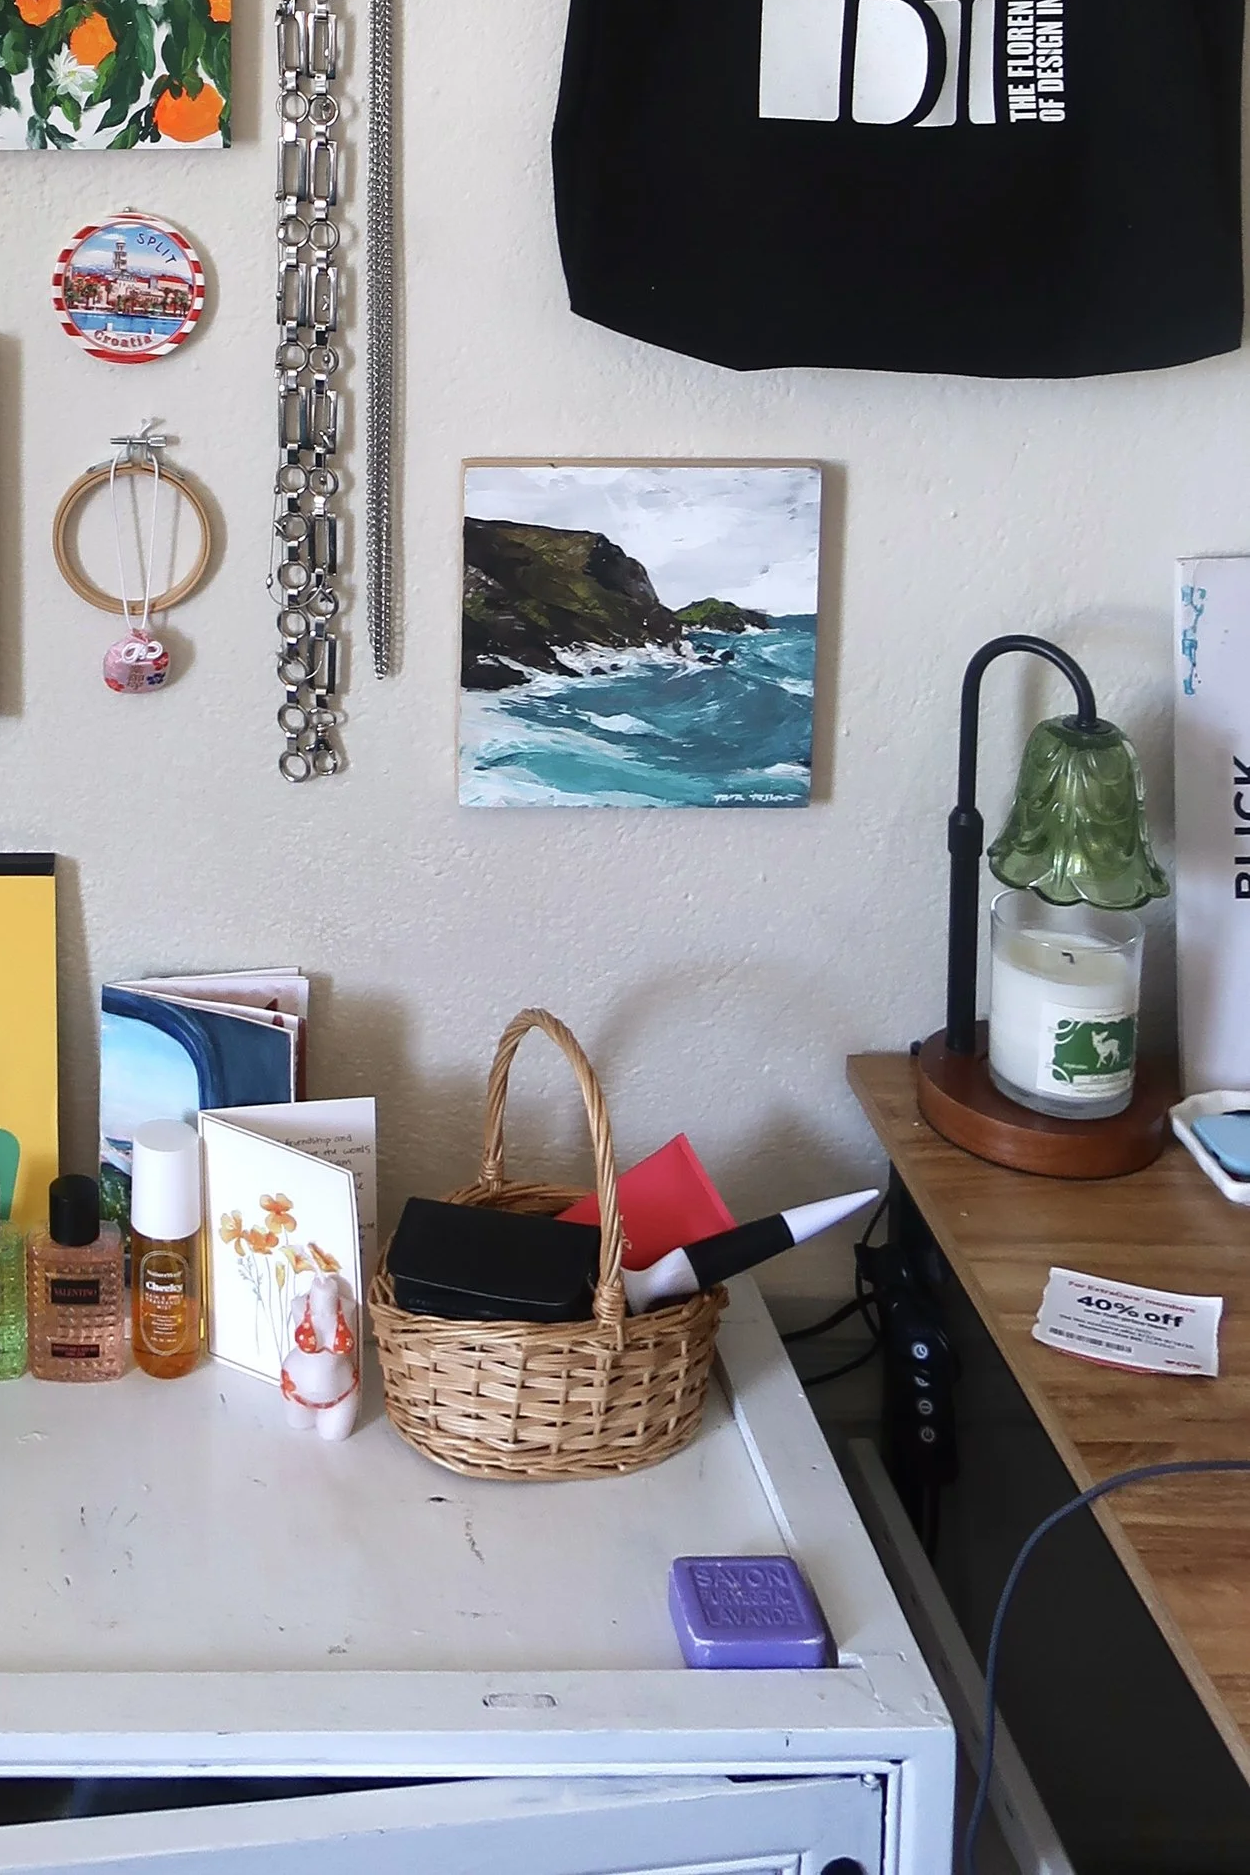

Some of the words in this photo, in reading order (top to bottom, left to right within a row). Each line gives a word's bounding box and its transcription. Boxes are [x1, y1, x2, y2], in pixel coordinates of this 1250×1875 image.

[1036, 21, 1064, 92] DESIGN
[1007, 84, 1037, 123] THE
[1038, 98, 1065, 123] OF
[137, 233, 177, 264] SPLIT
[93, 330, 153, 348] Croatia
[334, 1134, 352, 1143] and
[53, 1287, 97, 1297] VALENTINO
[145, 1280, 184, 1292] Cheeky
[1068, 1280, 1086, 1289] For
[1145, 1299, 1196, 1313] members
[1077, 1296, 1139, 1318] 40%
[1144, 1312, 1183, 1327] off
[694, 1568, 789, 1588] SAVON
[704, 1608, 799, 1626] LAVANDE
